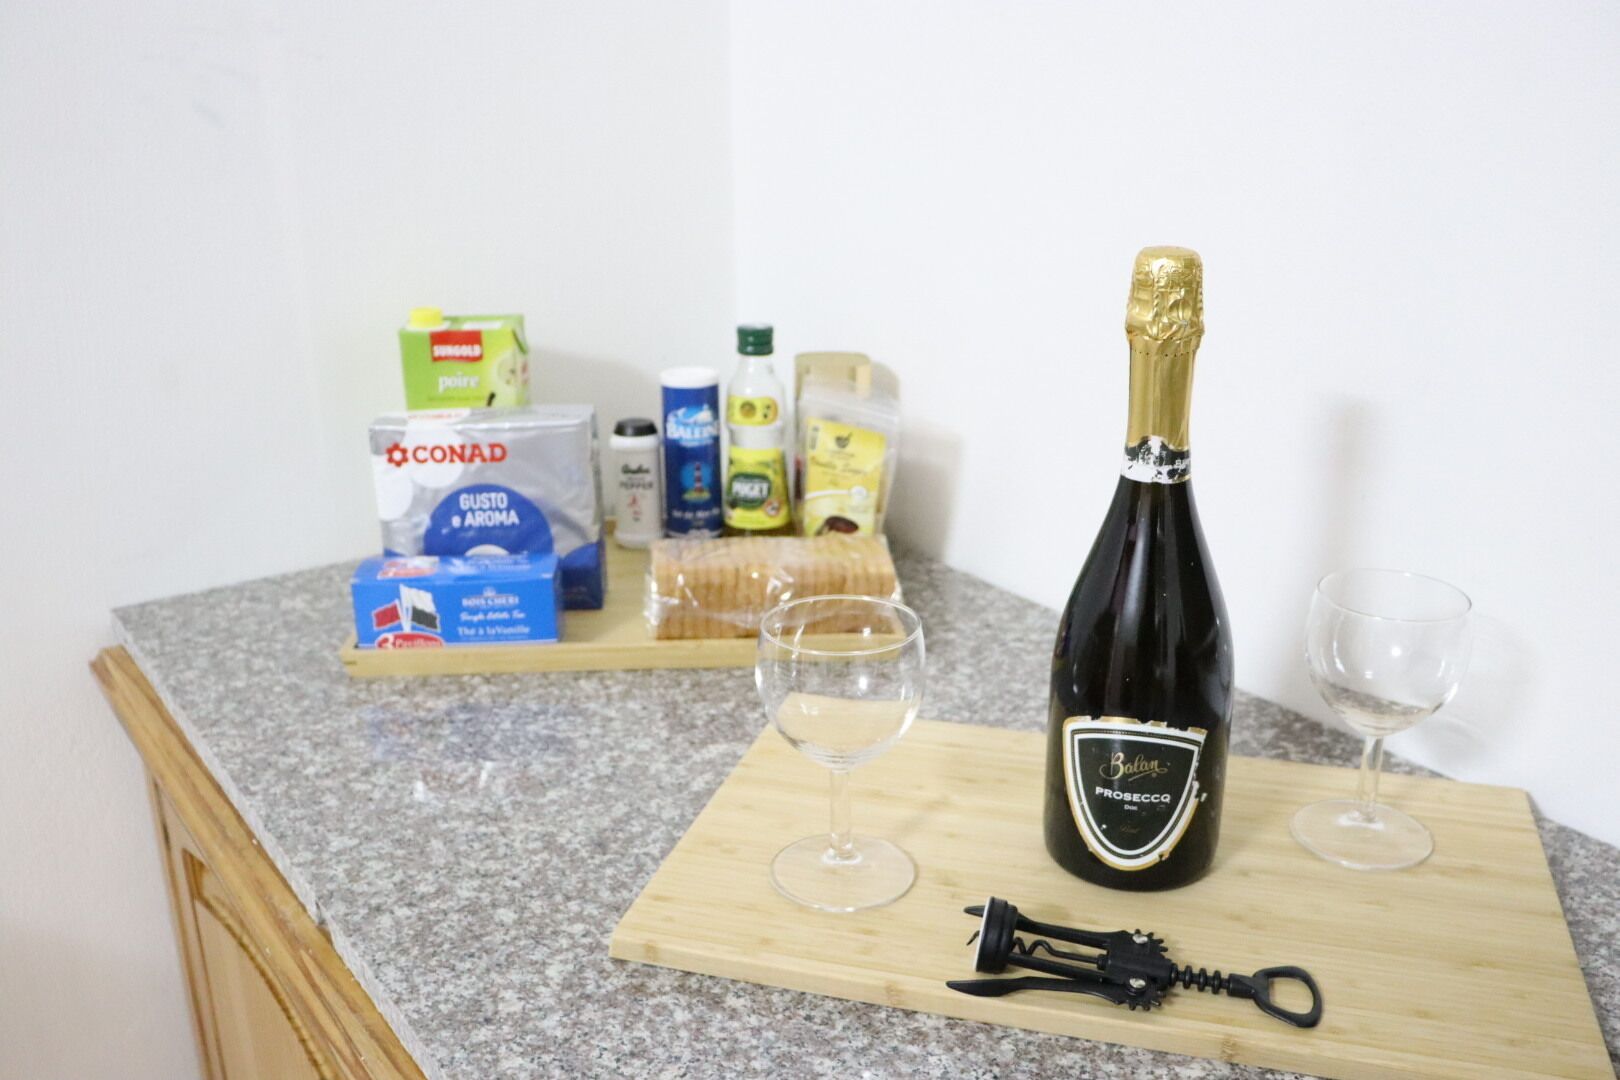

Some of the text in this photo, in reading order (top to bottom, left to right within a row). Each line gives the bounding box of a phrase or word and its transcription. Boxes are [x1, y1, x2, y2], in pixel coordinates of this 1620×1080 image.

[438, 371, 480, 393] poire
[412, 443, 508, 464] CONAD
[459, 492, 508, 511] GUSTO
[452, 509, 520, 528] e AROMA
[1099, 752, 1168, 781] Balan
